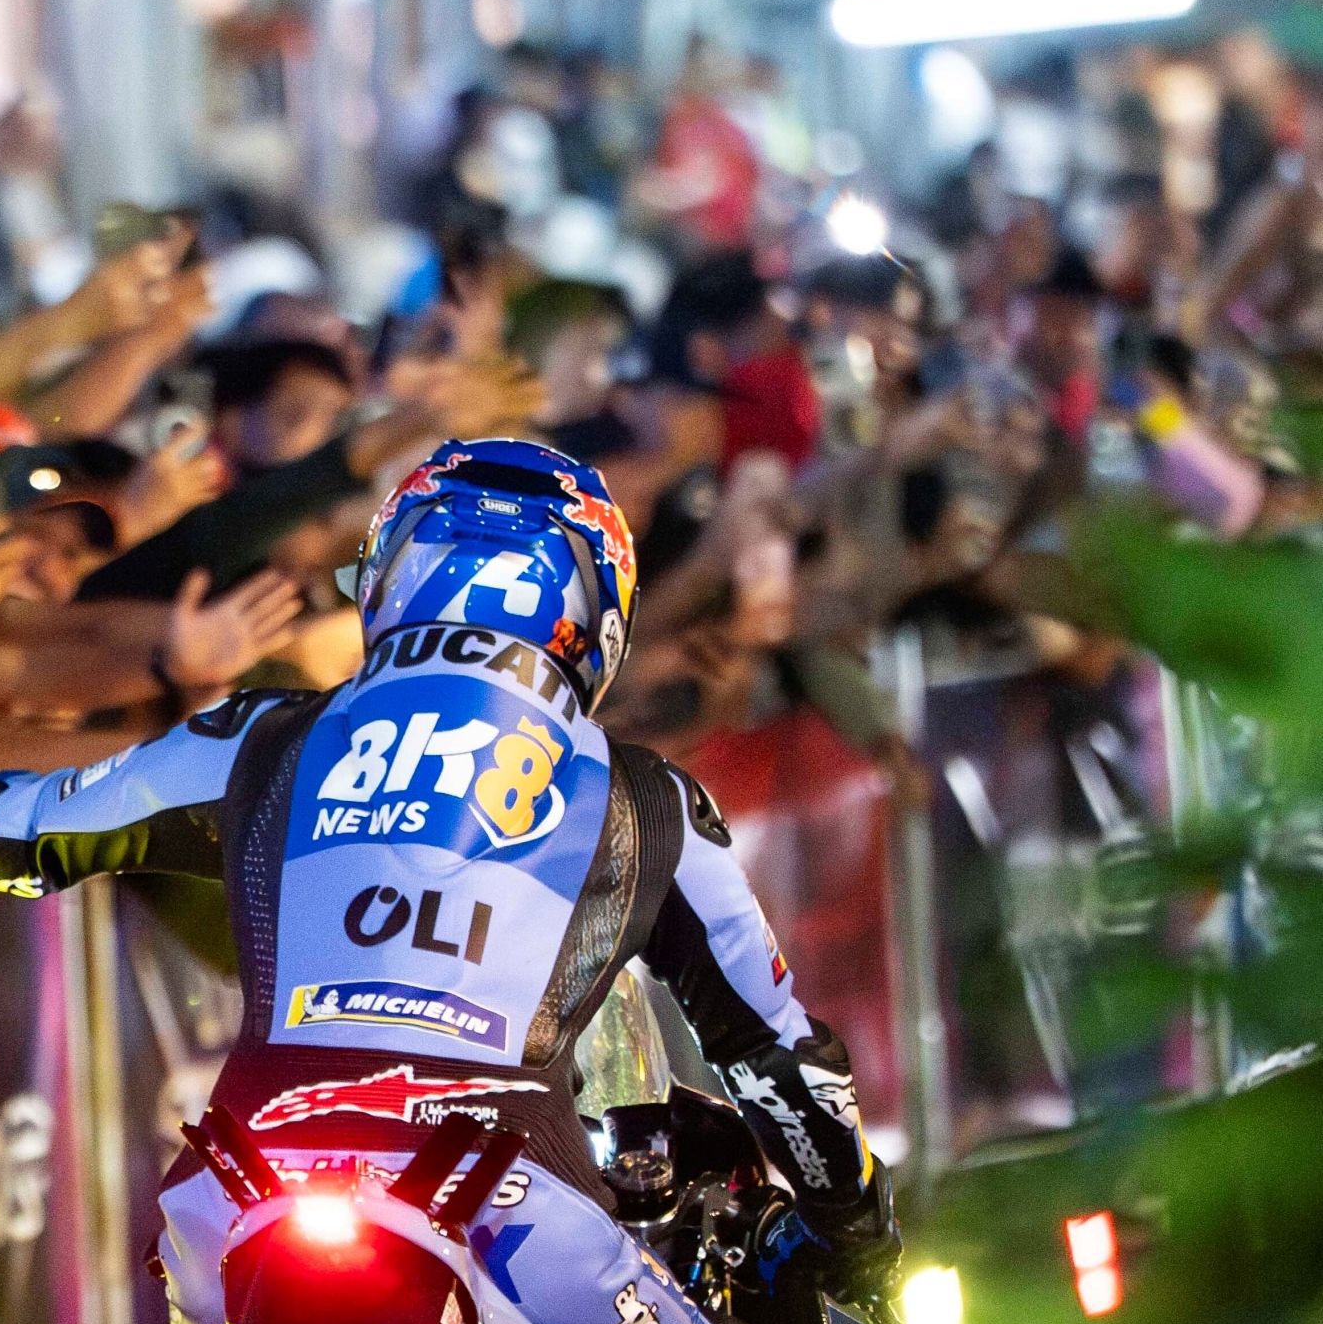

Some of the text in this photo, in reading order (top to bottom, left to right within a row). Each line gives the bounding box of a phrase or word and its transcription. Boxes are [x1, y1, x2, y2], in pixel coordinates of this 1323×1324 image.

[312, 800, 429, 840] NEWS
[344, 885, 492, 966] OLI
[345, 993, 491, 1035] MICHELIN
